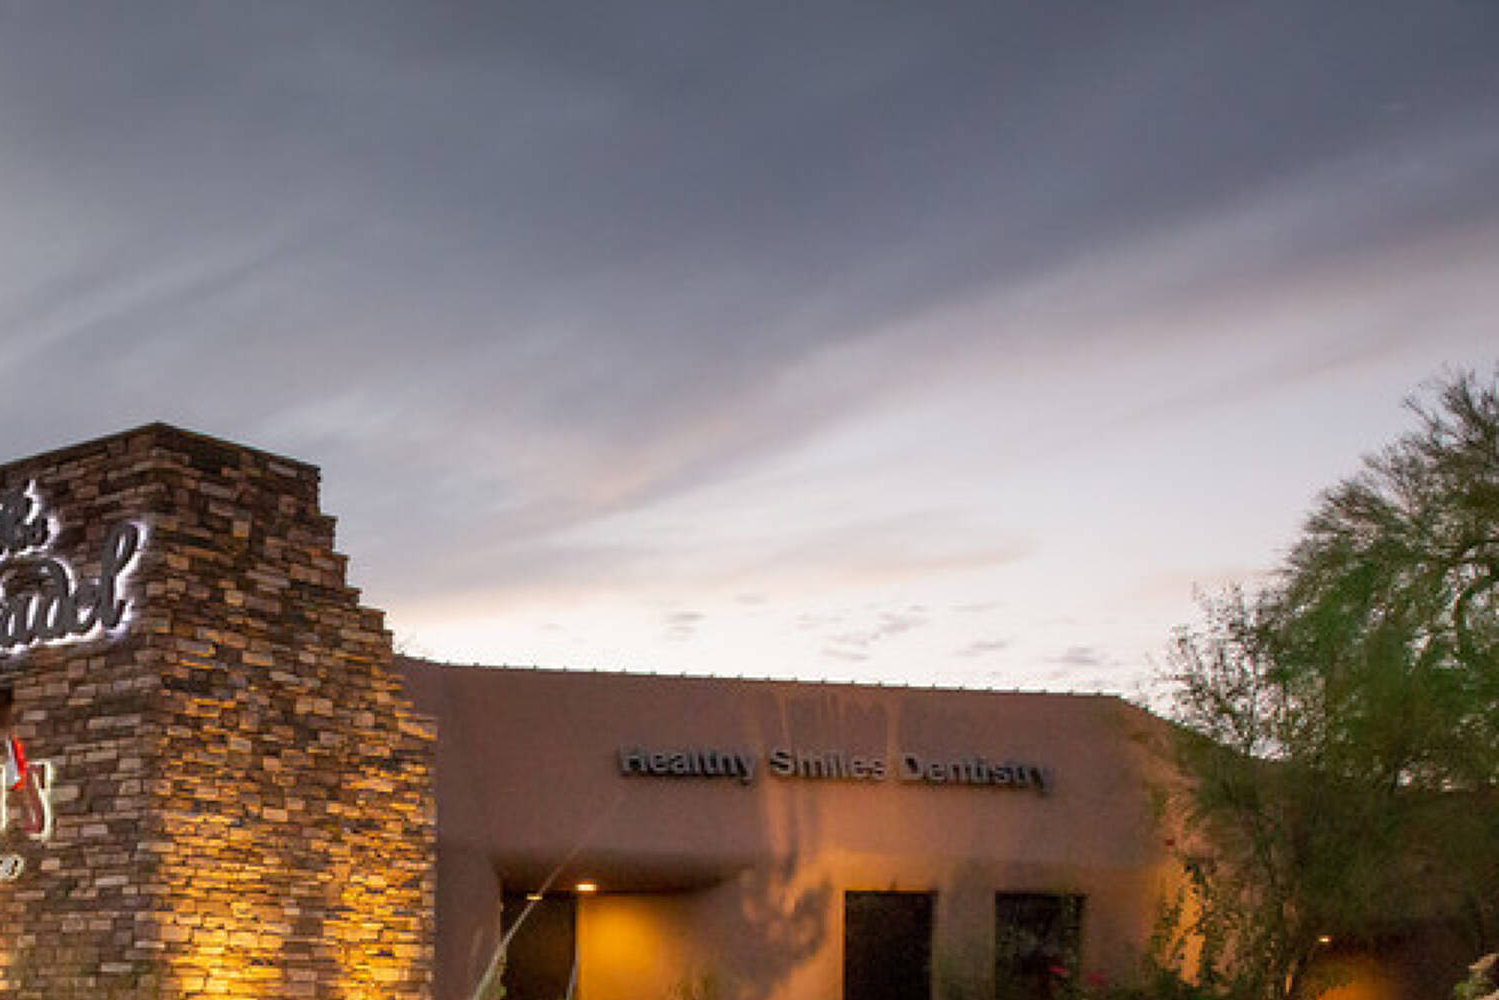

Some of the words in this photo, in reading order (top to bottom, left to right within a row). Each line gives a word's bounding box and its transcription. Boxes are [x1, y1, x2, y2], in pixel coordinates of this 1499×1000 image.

[619, 745, 758, 786] Healthy
[769, 747, 887, 781] Smiles
[900, 753, 1053, 796] Dentistry
